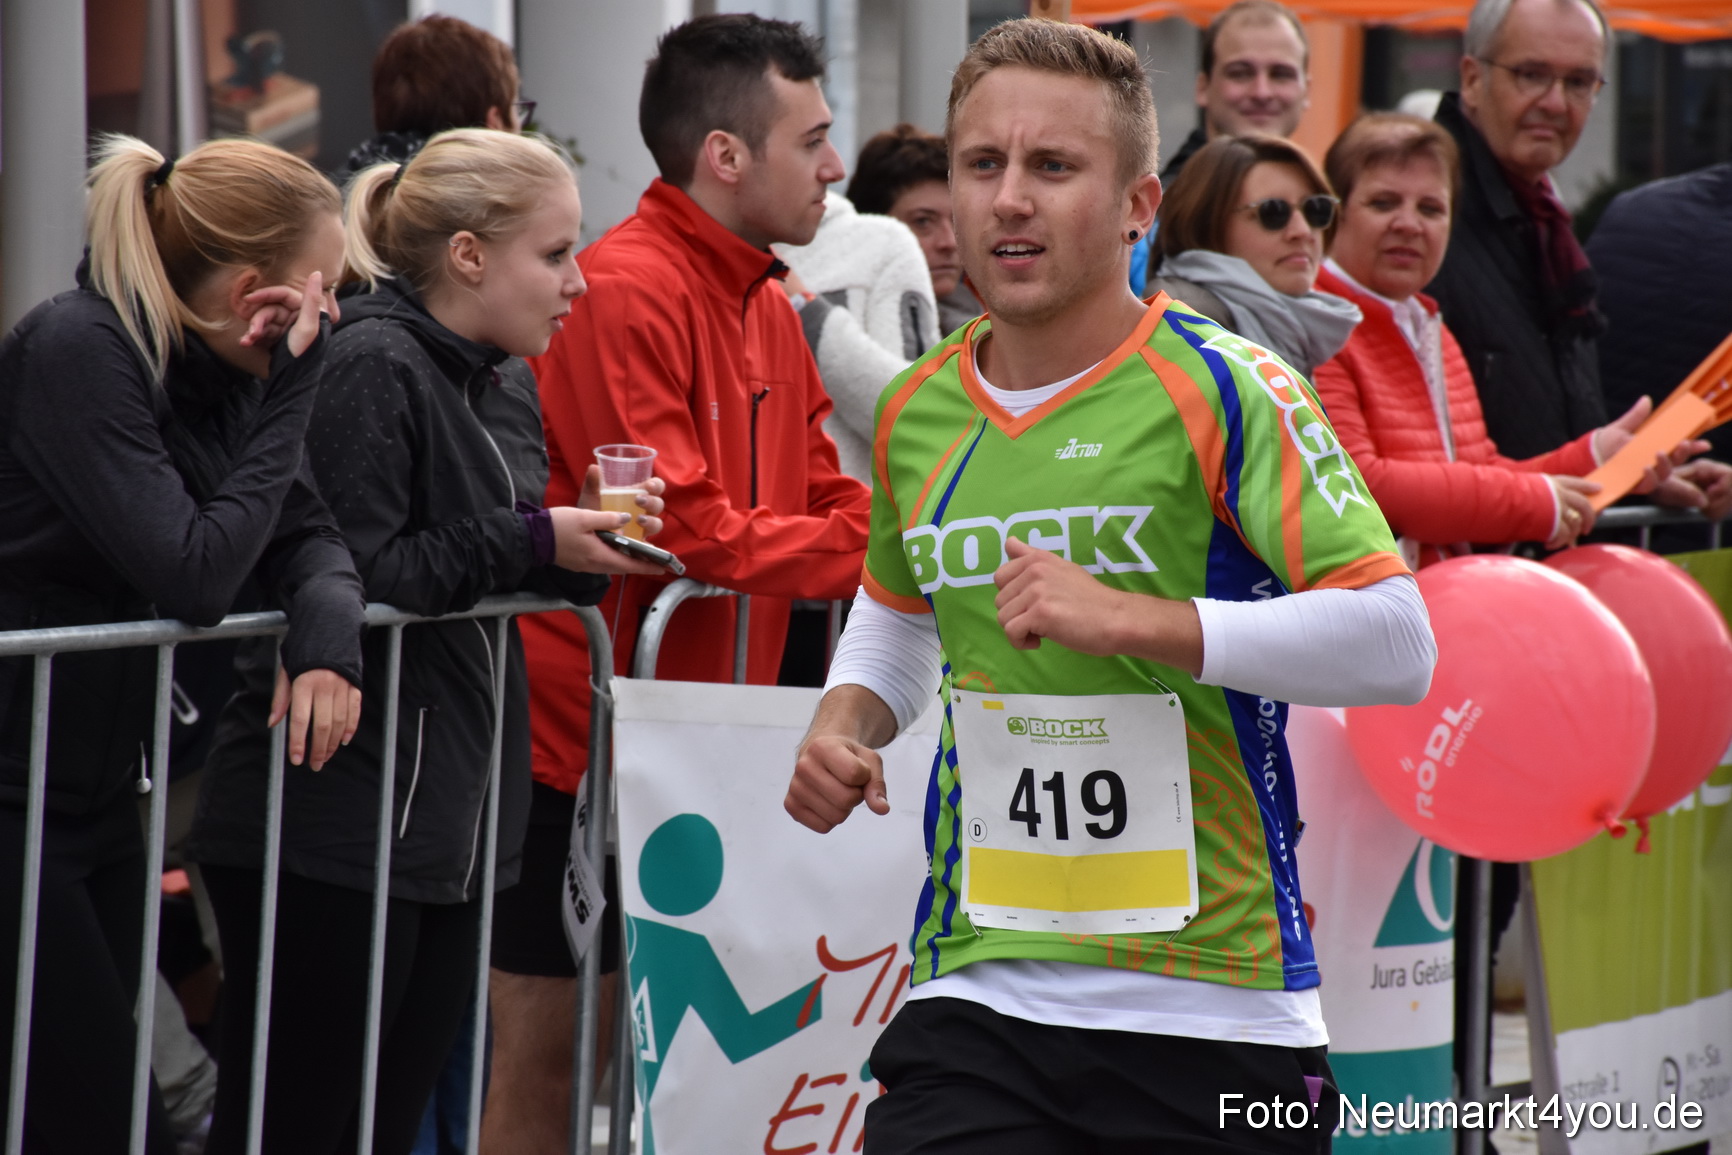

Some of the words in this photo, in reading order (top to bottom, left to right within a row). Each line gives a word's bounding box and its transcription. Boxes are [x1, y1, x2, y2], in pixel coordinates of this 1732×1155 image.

[1200, 331, 1370, 518] BOCK
[902, 505, 1159, 594] BOCK
[1028, 717, 1109, 738] BOCK
[1030, 737, 1050, 745] inspired
[1079, 737, 1110, 746] concepts
[1008, 767, 1128, 842] 419
[974, 824, 981, 837] D
[1370, 962, 1406, 990] Jura
